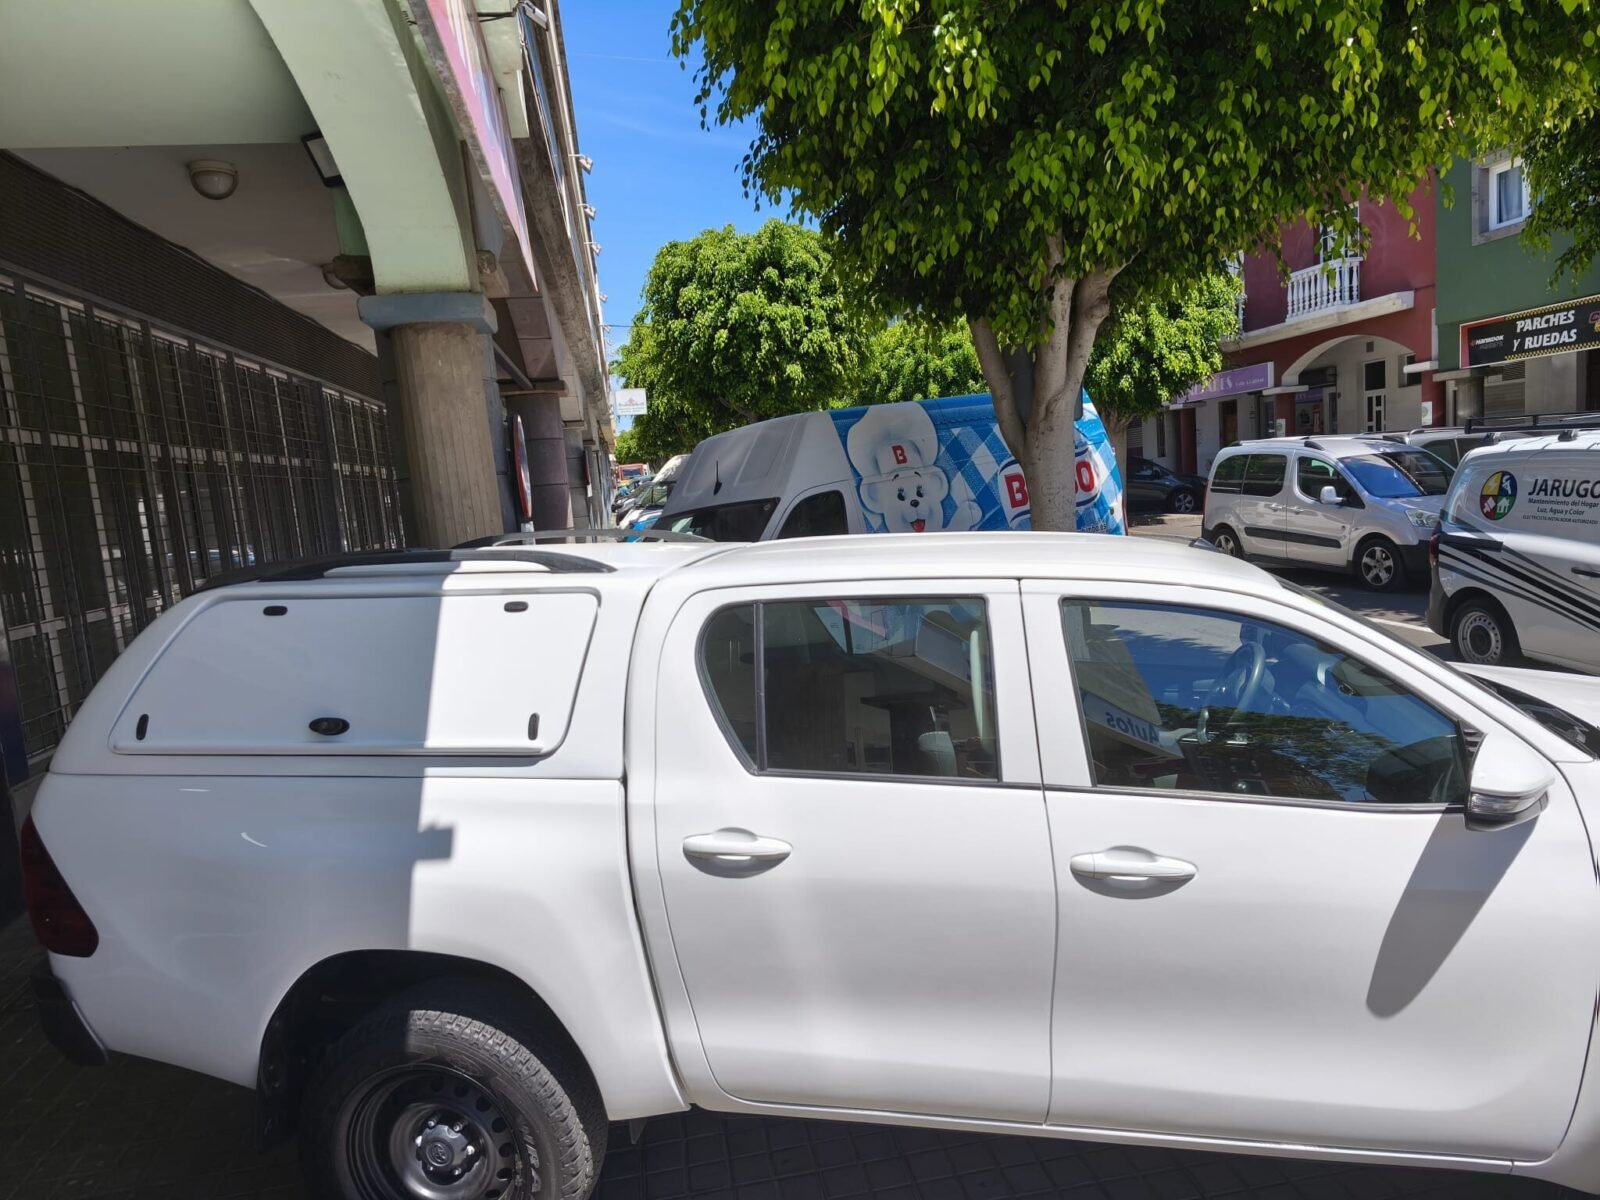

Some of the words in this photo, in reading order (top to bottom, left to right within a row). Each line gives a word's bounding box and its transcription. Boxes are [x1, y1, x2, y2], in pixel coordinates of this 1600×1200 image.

[1515, 310, 1576, 333] PARCHES
[1513, 338, 1521, 352] Y
[1524, 328, 1578, 350] RUEDAS
[891, 445, 908, 465] B
[1528, 497, 1570, 506] Mantenimiento
[1581, 500, 1600, 509] Hogar
[1549, 506, 1564, 516] Agua
